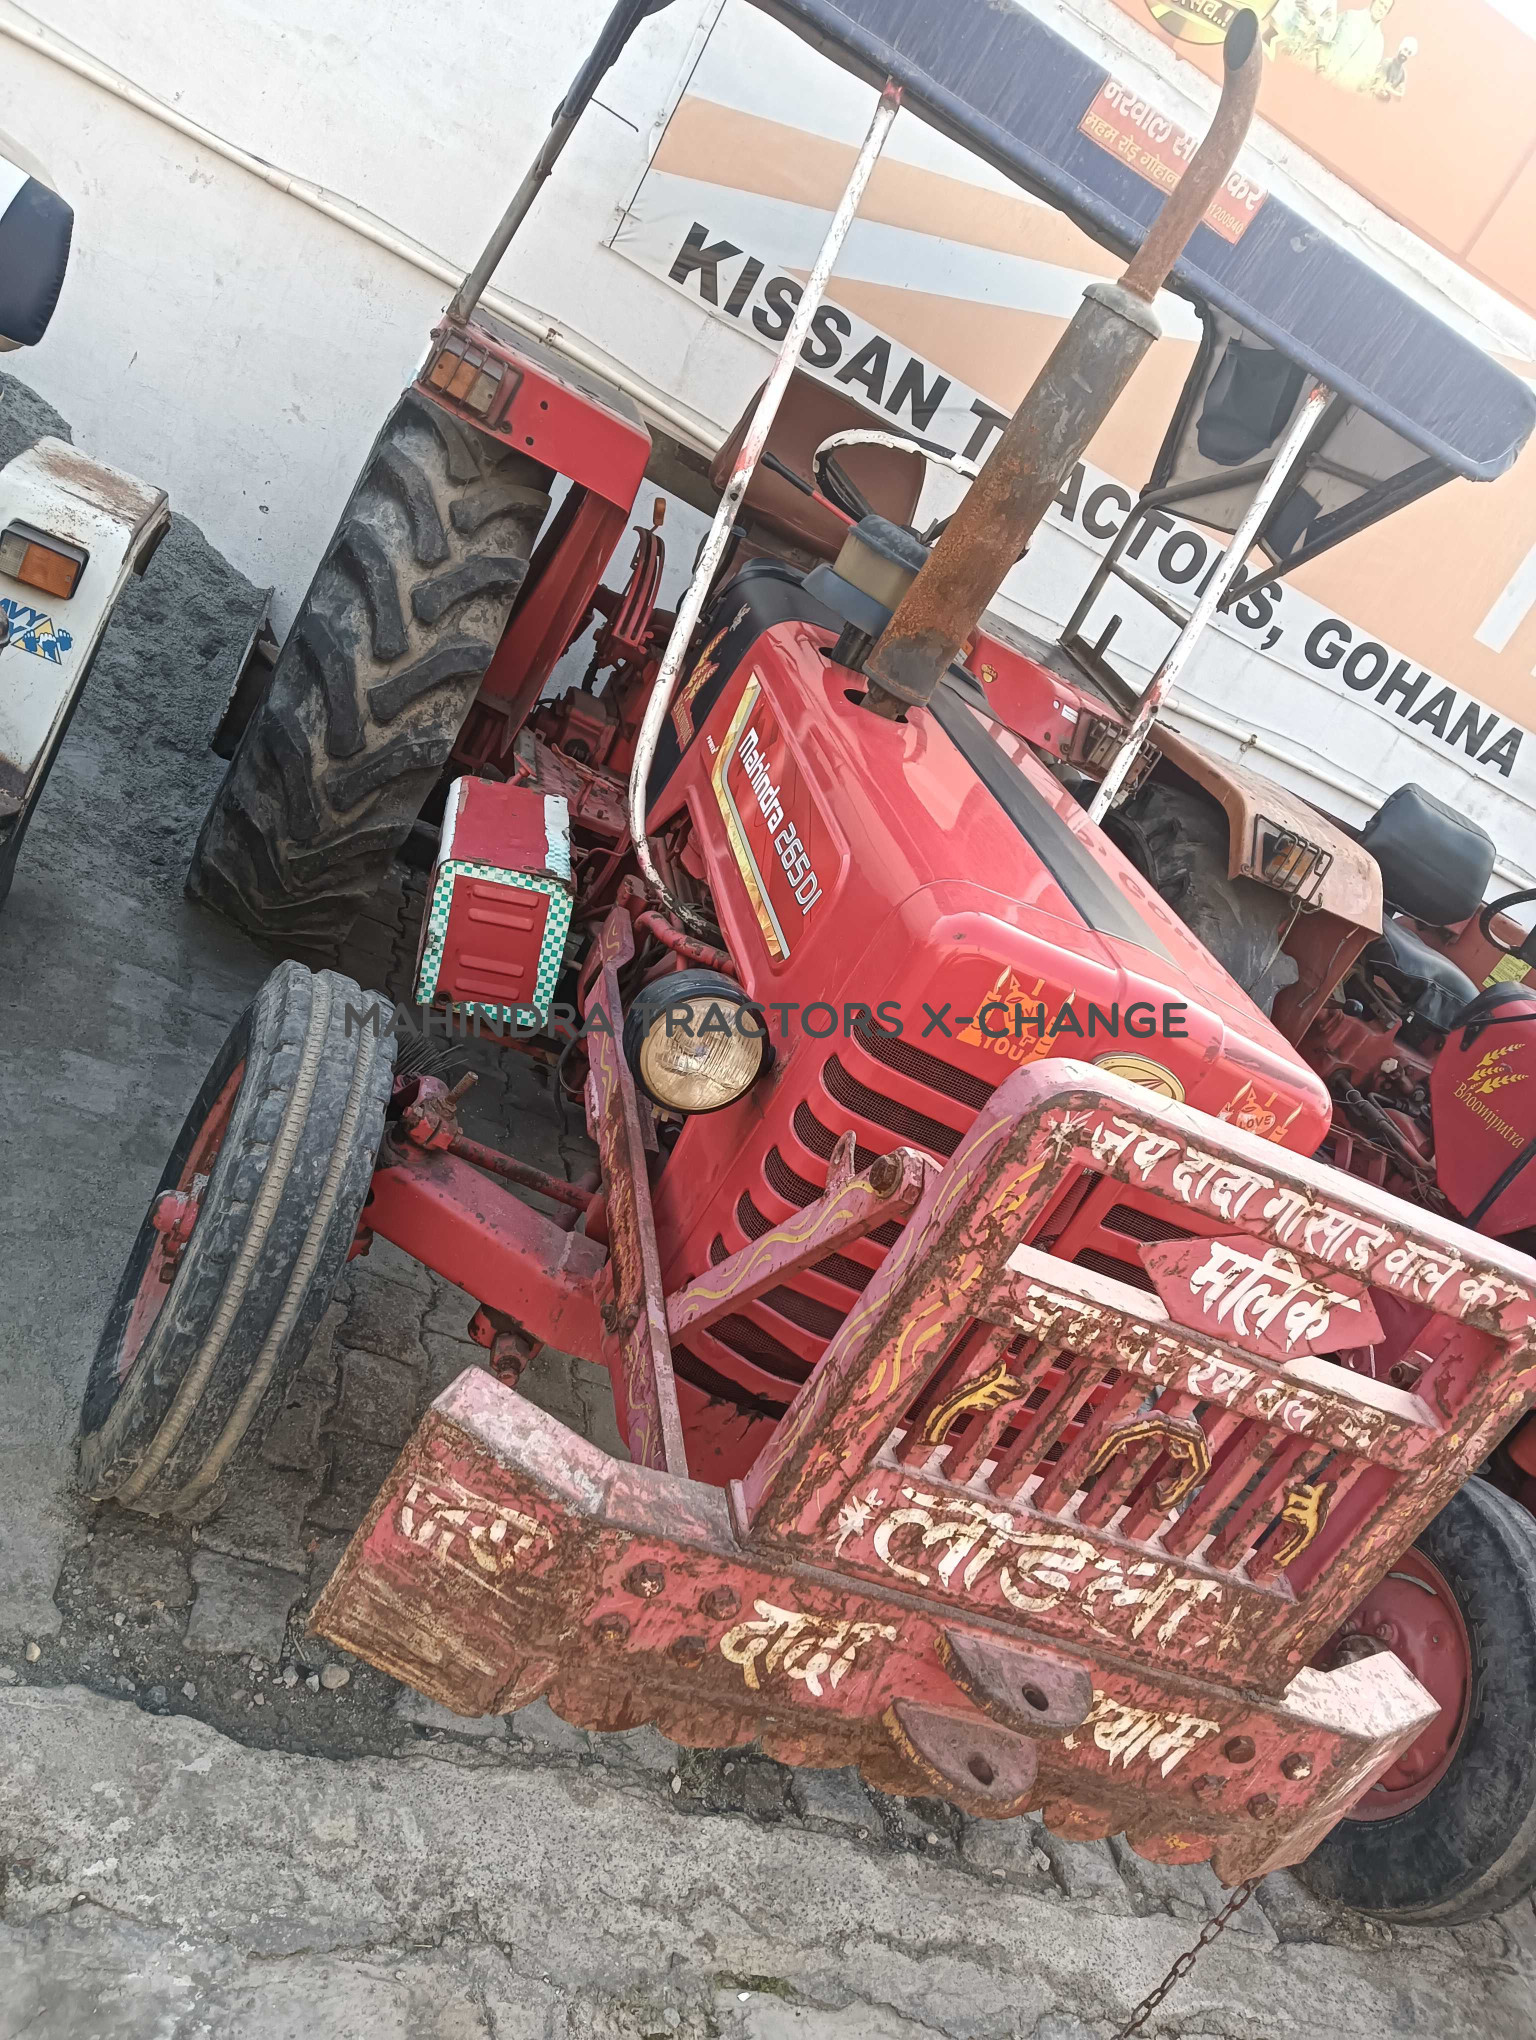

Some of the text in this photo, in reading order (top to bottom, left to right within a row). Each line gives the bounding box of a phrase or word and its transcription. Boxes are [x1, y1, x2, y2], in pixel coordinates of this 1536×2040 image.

[1083, 111, 1119, 143] महम
[1139, 149, 1181, 190] गोहान
[1103, 80, 1174, 144] नरवाल
[668, 221, 952, 433] KISSAN
[1303, 618, 1525, 778] GOHANA
[1454, 1081, 1525, 1149] Bhoomiputra
[1091, 1116, 1182, 1182] जय
[1172, 1144, 1275, 1220] दादा
[1188, 1240, 1362, 1354] मालिक
[873, 1486, 1223, 1650] लाडला
